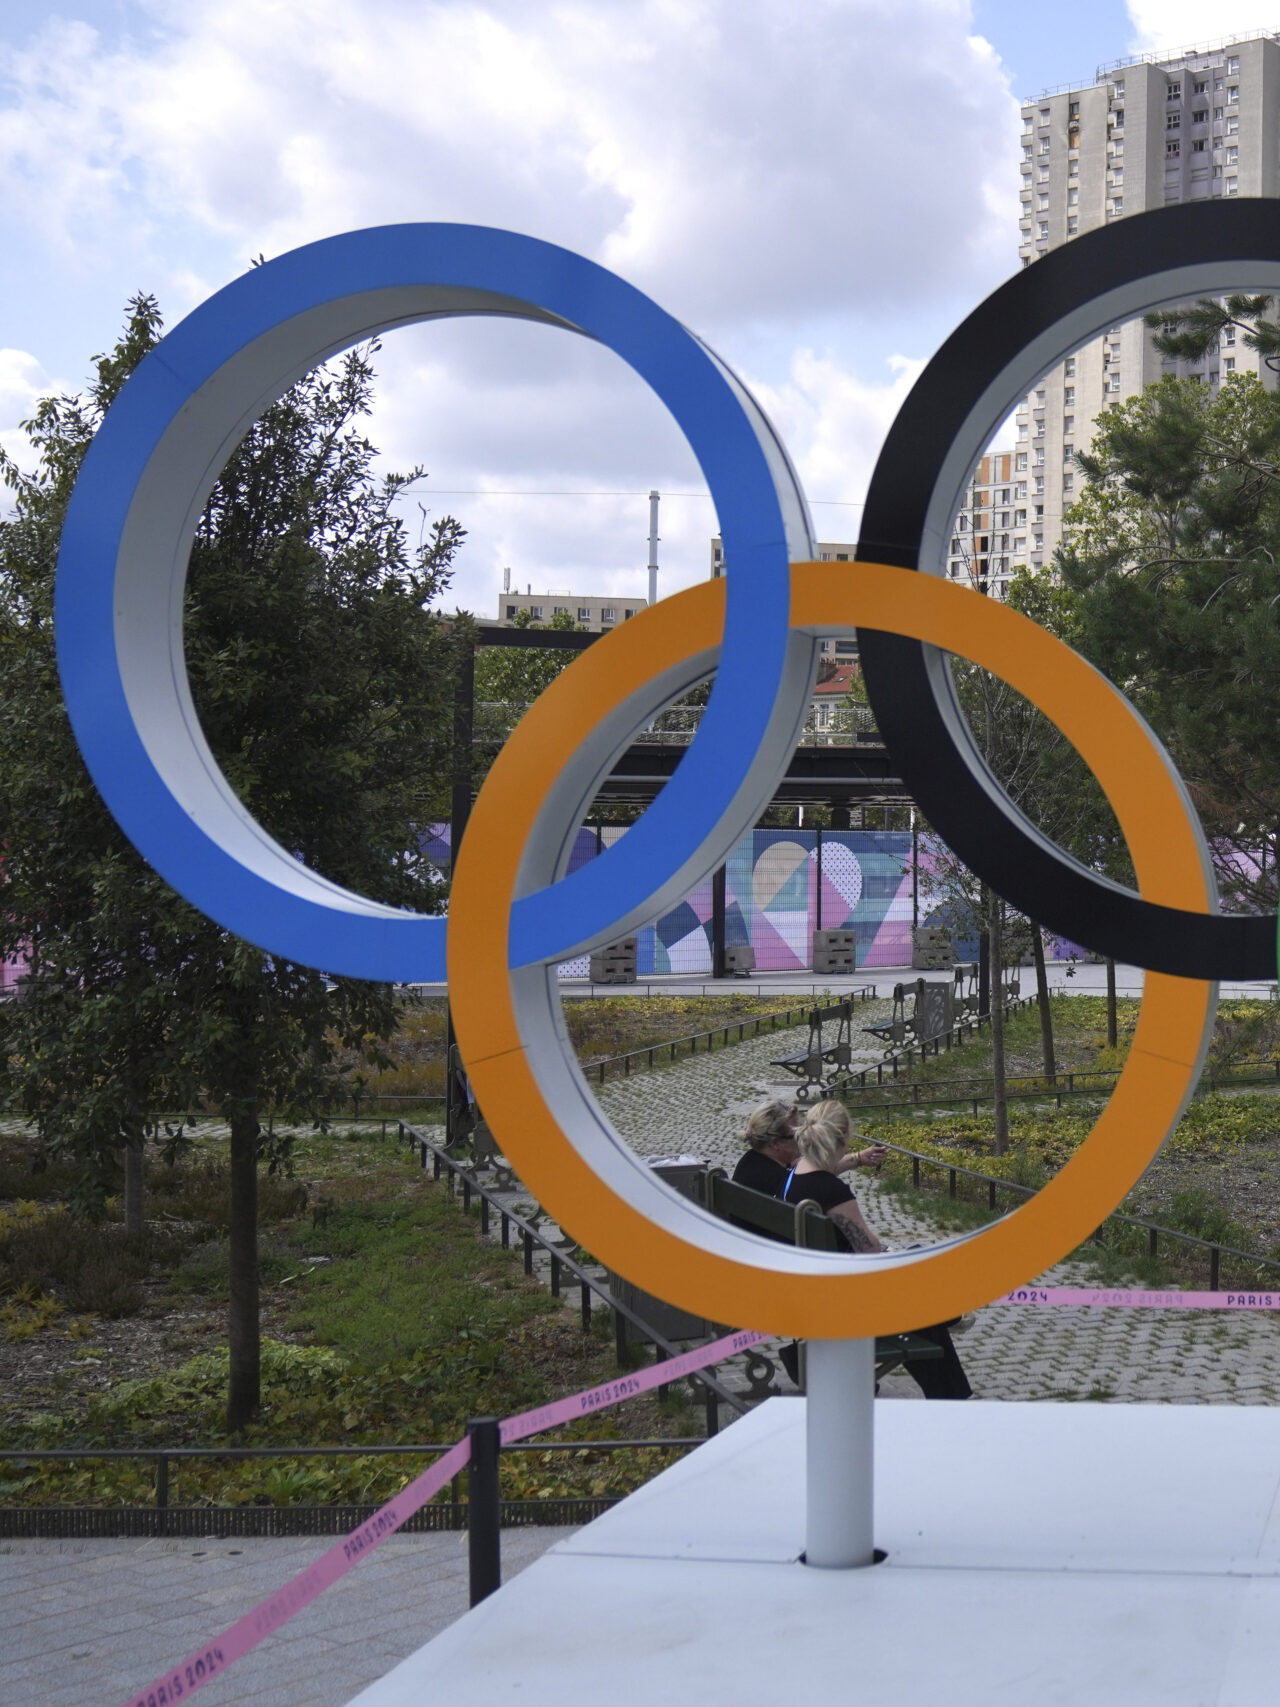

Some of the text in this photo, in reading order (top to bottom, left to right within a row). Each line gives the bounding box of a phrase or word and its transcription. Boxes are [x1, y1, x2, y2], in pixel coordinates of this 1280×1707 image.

[1008, 1290, 1047, 1302] 2024
[1227, 1295, 1272, 1306] PARIS
[581, 1379, 640, 1409] PARIS 2024
[343, 1527, 373, 1561] PARIS
[185, 1648, 224, 1687] 2024
